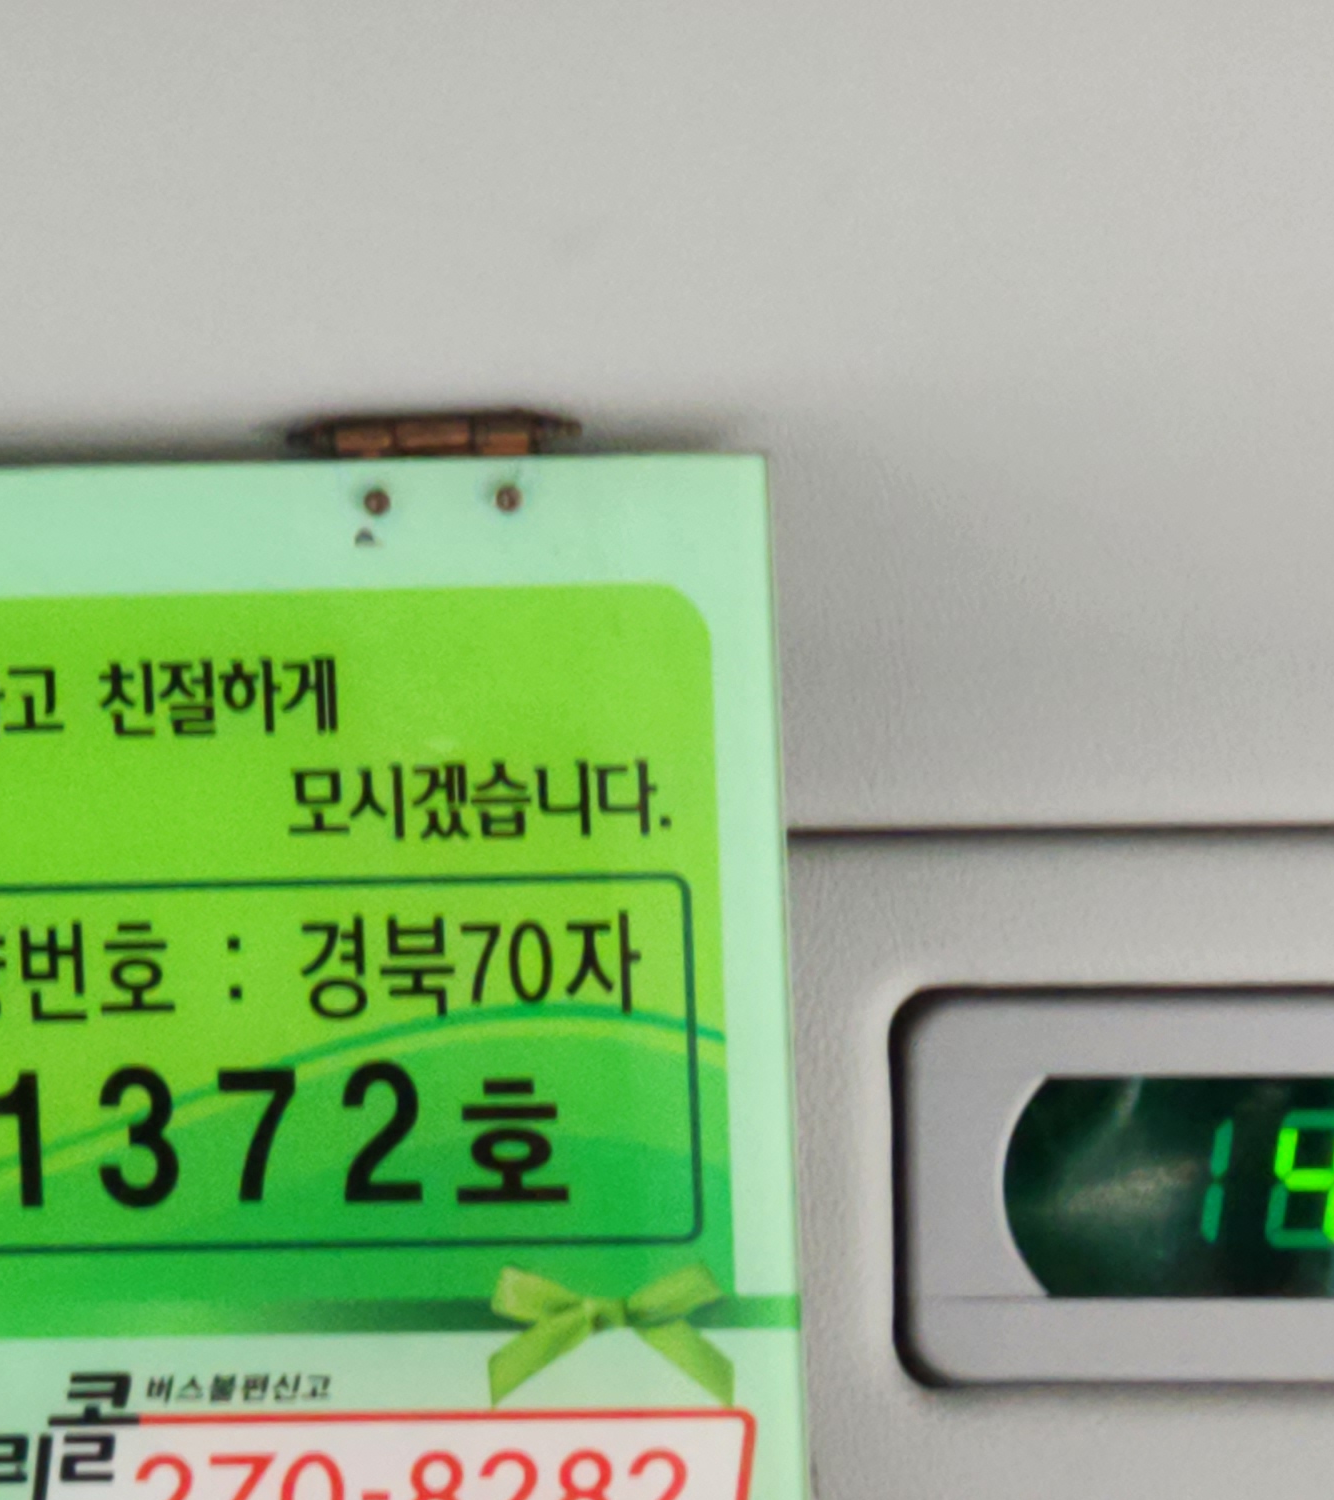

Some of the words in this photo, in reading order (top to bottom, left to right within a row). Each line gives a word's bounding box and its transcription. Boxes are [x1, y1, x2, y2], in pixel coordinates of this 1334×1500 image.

[98, 655, 339, 737] 친절하게
[288, 759, 672, 840] 모시겠습니다.
[300, 910, 642, 1020] 경북70자
